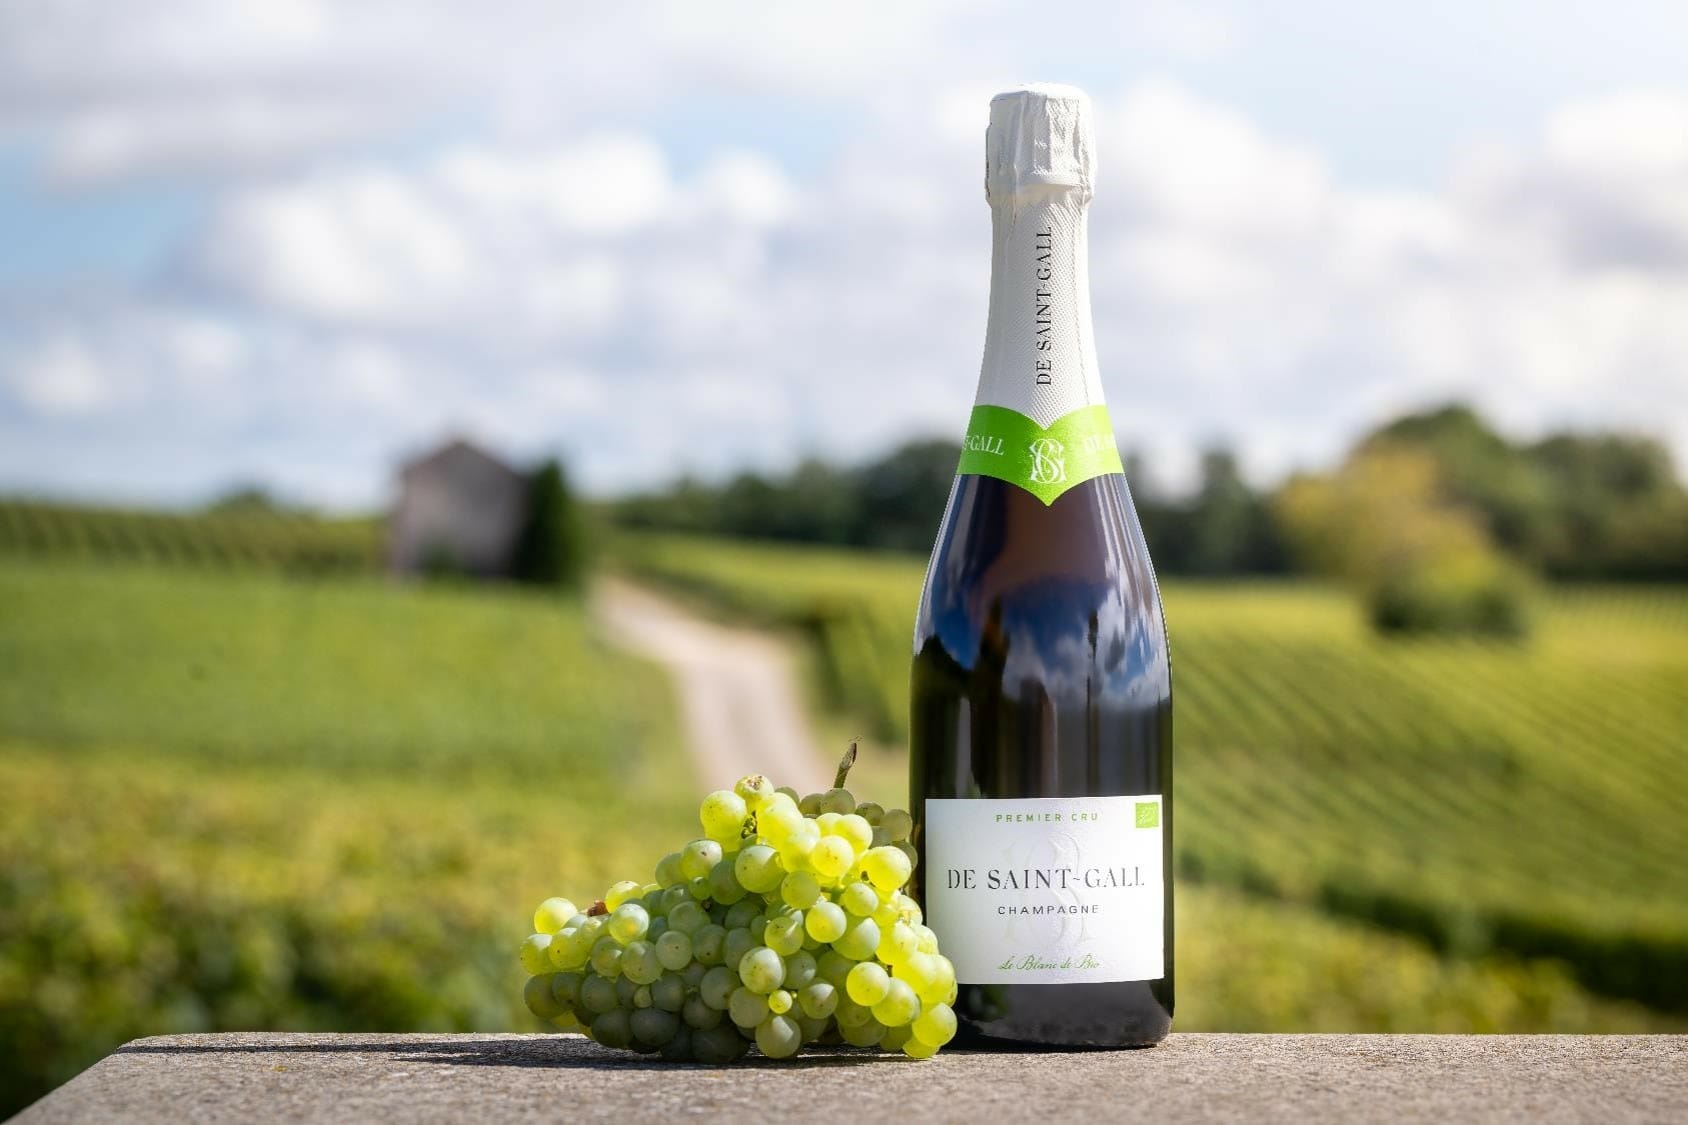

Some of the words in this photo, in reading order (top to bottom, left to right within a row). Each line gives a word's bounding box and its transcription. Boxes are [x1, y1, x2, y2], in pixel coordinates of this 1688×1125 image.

[1036, 226, 1052, 352] SAINT-GALL
[1036, 359, 1051, 386] DE
[995, 814, 1063, 823] PREMIER
[1070, 812, 1099, 822] CRU
[947, 869, 976, 890] DE
[998, 905, 1099, 915] CHAMPAGNE
[997, 955, 1014, 970] Le
[1016, 954, 1057, 970] Blanc
[1060, 956, 1072, 969] de
[1074, 953, 1100, 969] Bio
